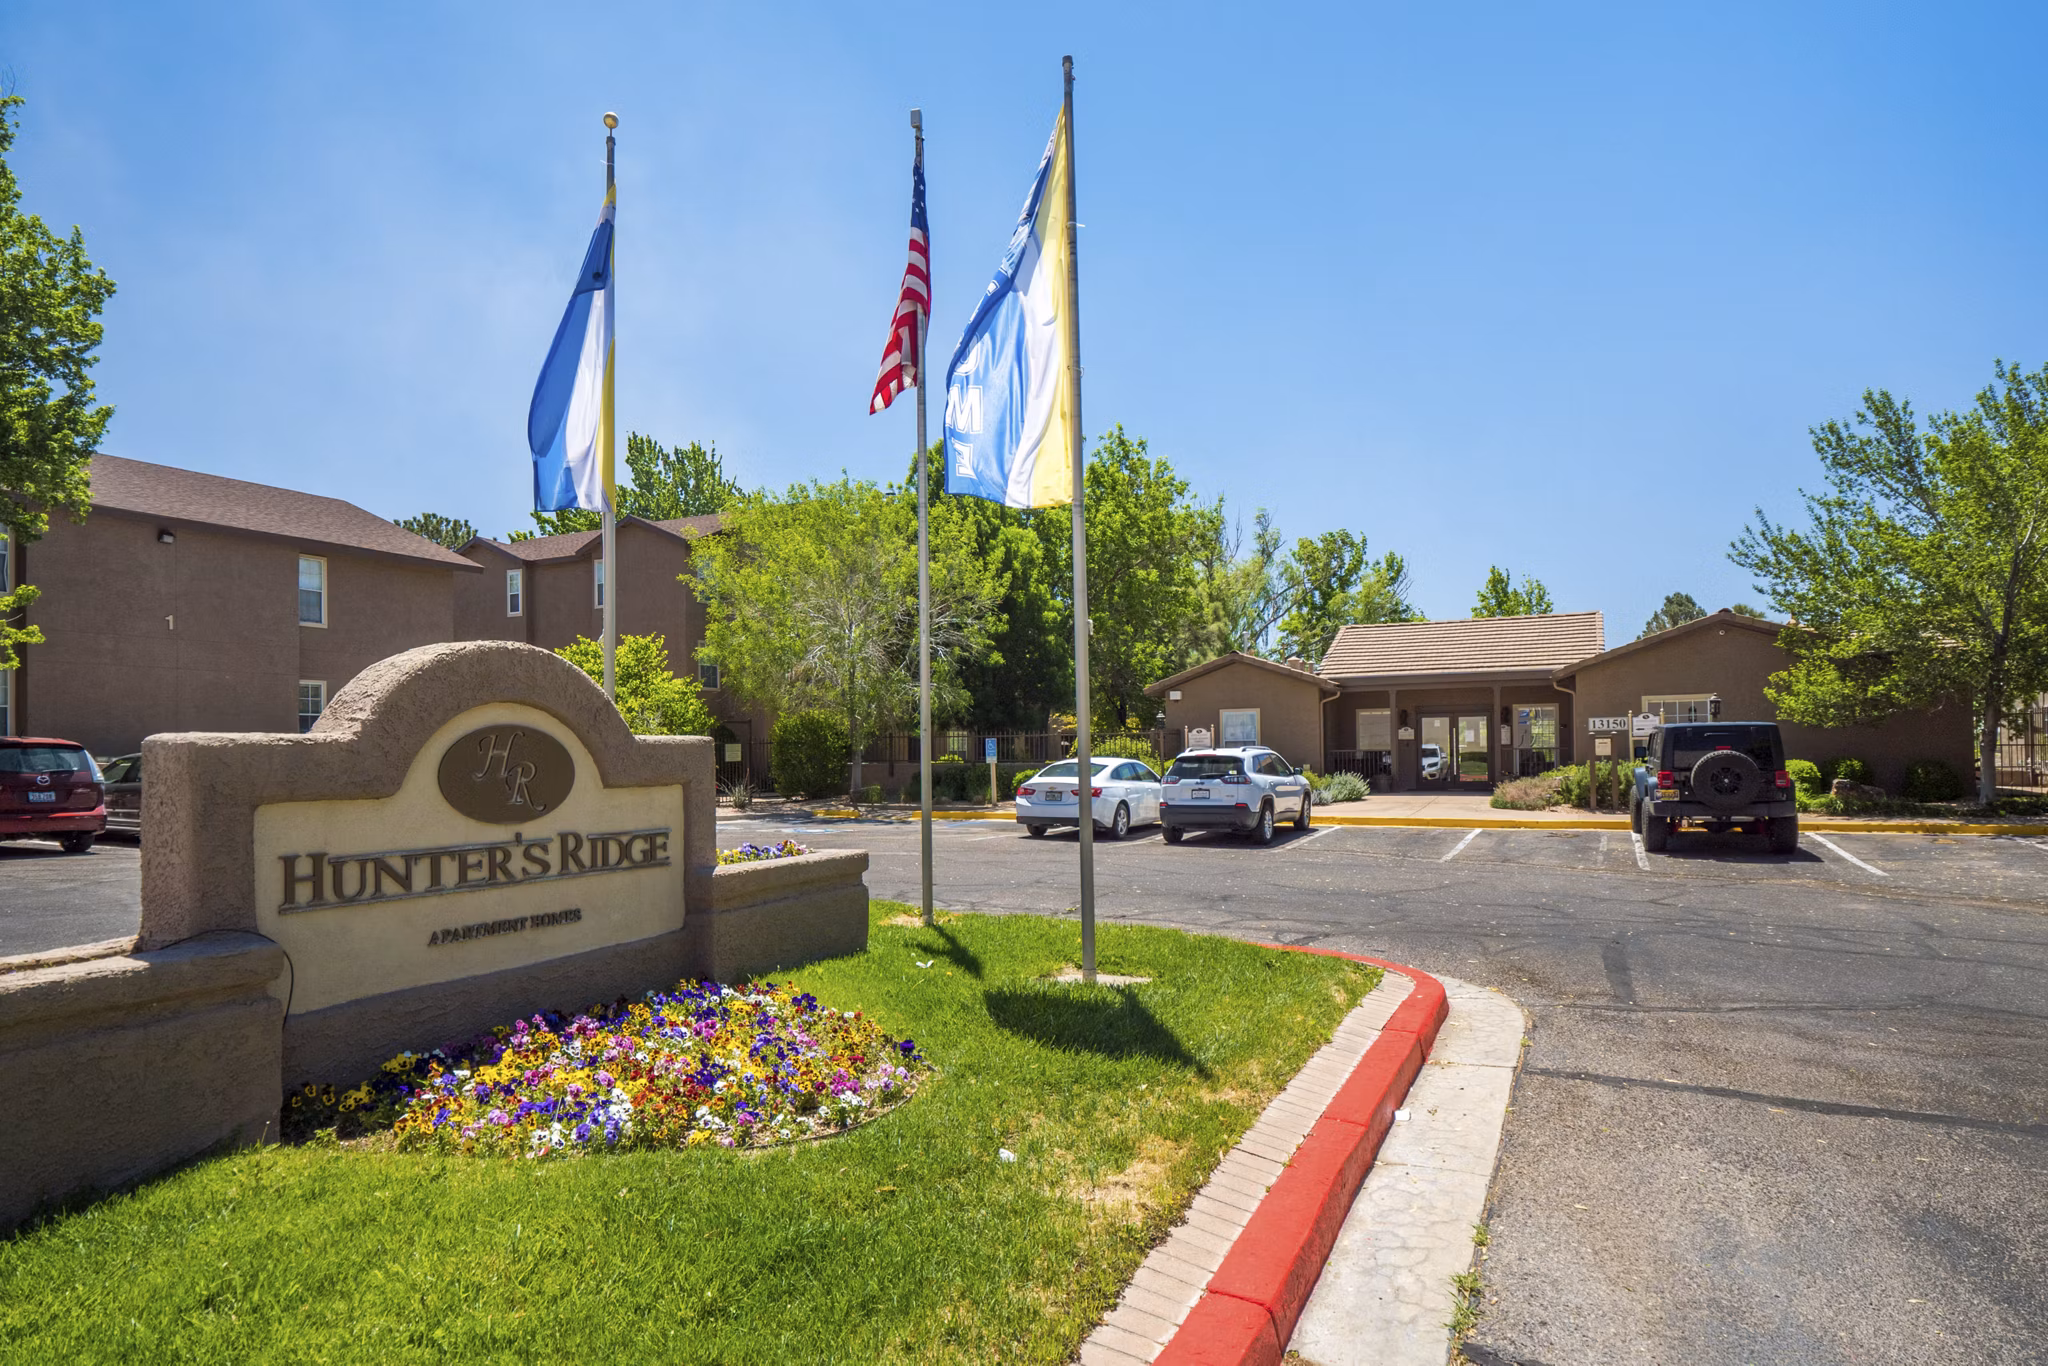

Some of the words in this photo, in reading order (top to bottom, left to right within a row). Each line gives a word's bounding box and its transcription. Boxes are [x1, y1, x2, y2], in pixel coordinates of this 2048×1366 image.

[165, 615, 174, 630] 1
[1592, 719, 1626, 729] 13150
[279, 832, 552, 912] HUNTER'S
[557, 830, 672, 876] RIDGE
[427, 916, 528, 947] APARTMENT
[530, 908, 582, 929] HOMES
